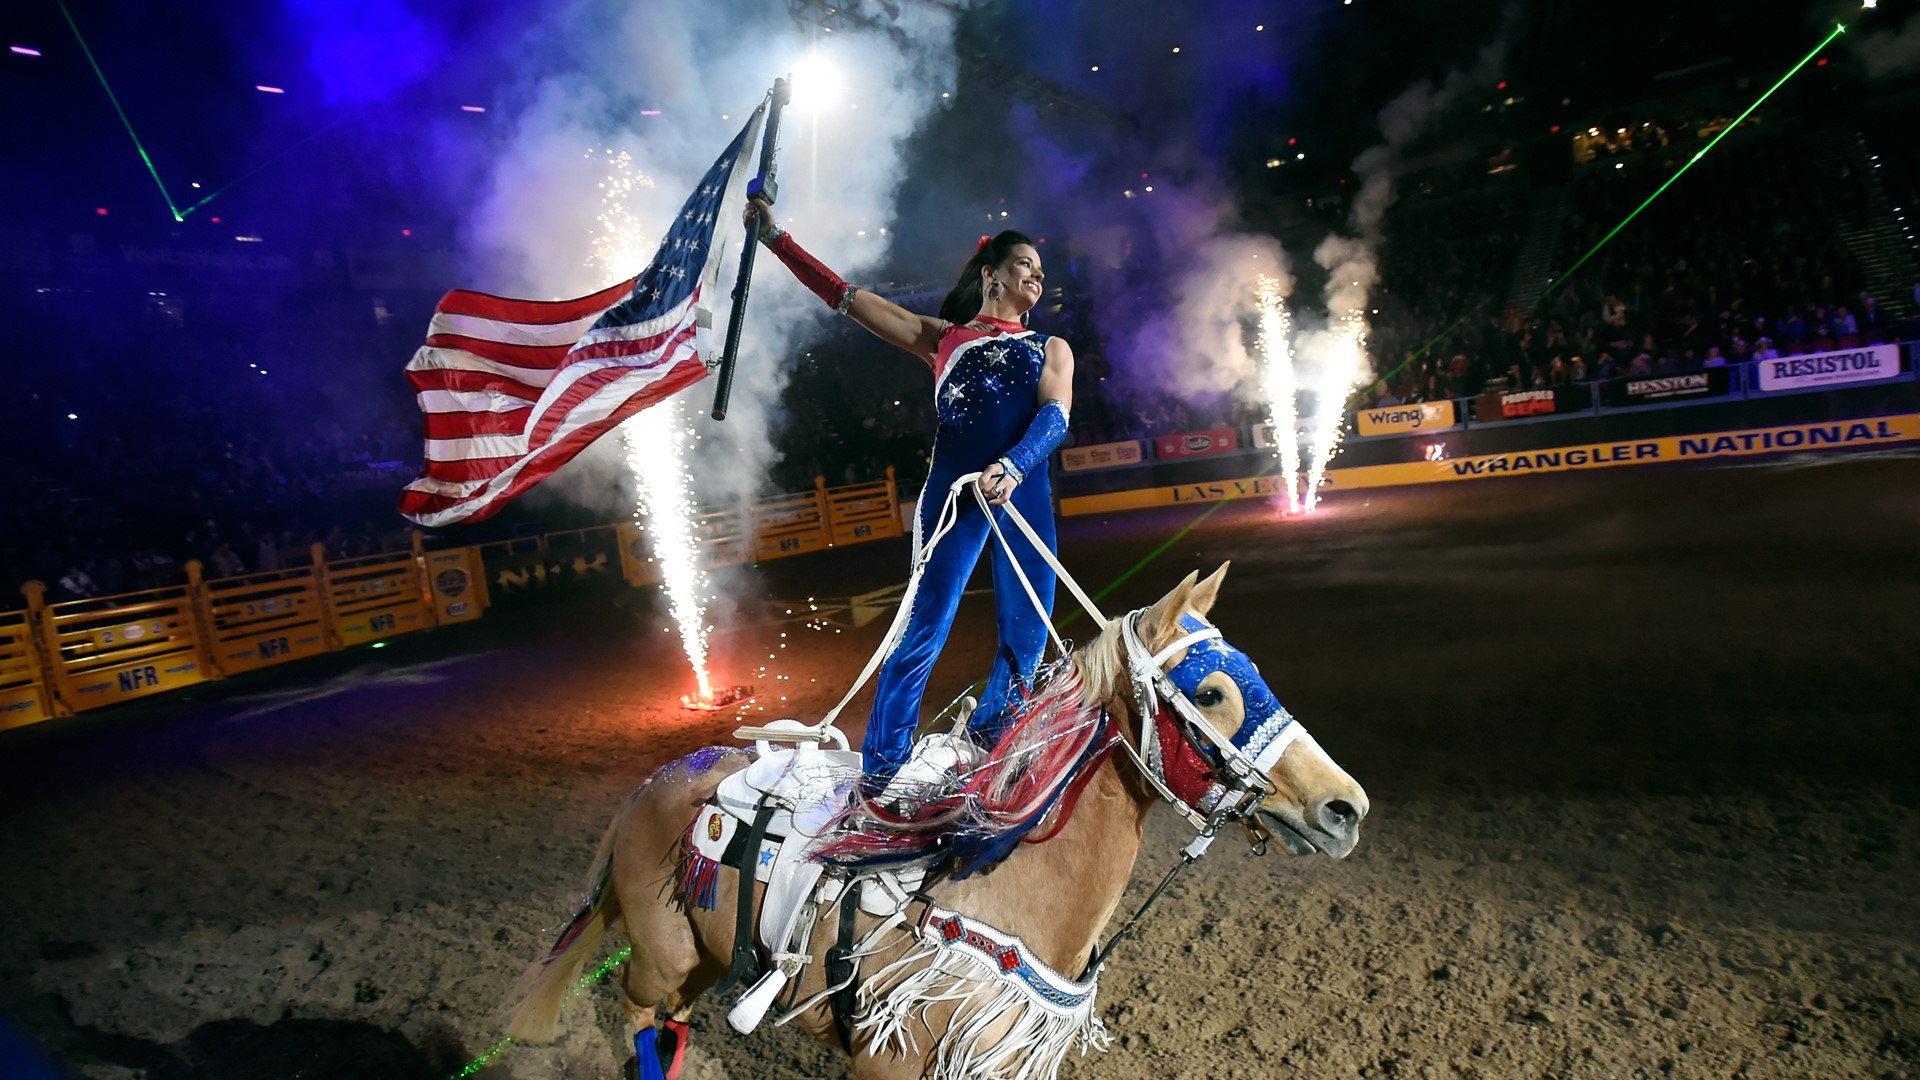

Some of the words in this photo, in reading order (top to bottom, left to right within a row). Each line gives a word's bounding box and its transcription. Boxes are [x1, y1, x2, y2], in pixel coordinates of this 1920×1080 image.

[1774, 351, 1881, 379] RESISTOL
[1627, 374, 1708, 395] HESSTON
[1368, 404, 1442, 429] Wranglr
[1453, 443, 1659, 475] WRANGLER
[1680, 421, 1901, 456] NATIONAL
[1172, 483, 1225, 502] LAS
[103, 631, 113, 643] 2
[259, 637, 290, 659] NFR
[118, 666, 159, 692] NFR
